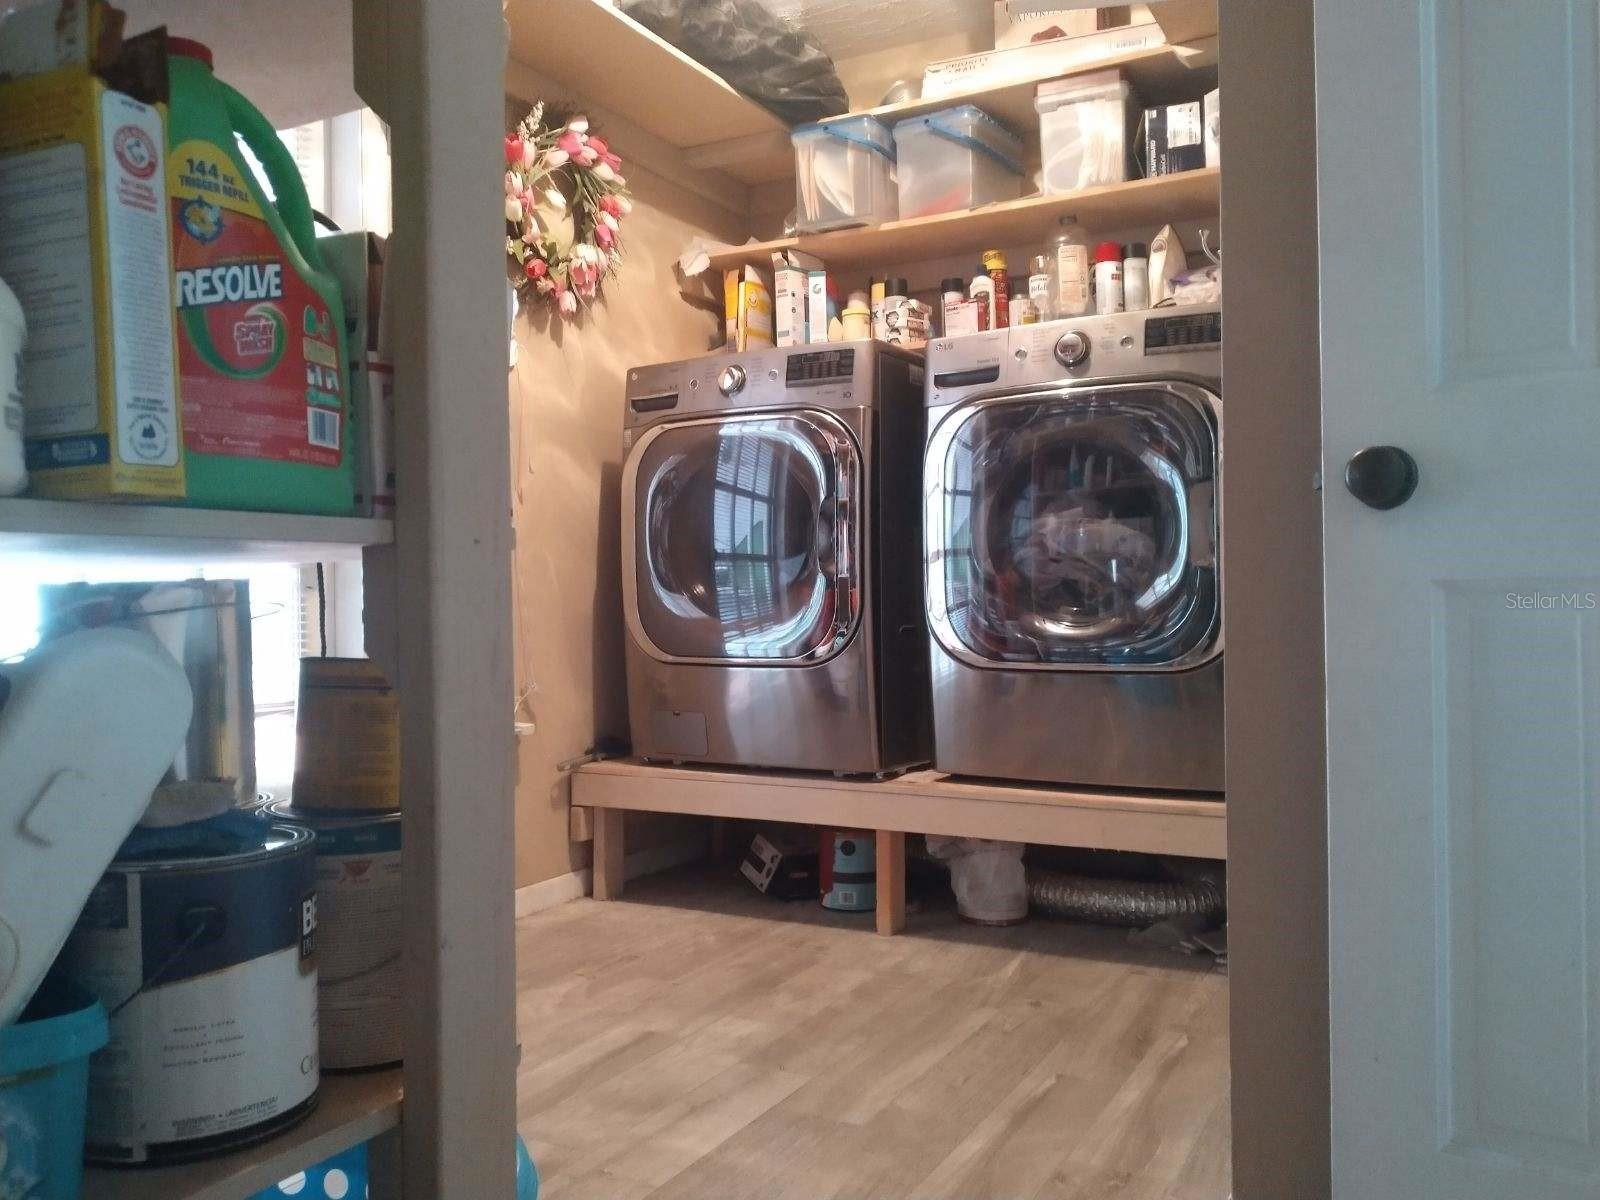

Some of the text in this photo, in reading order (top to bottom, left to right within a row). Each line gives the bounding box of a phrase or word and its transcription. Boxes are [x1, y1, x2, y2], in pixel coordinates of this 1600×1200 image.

[185, 158, 219, 177] 144
[178, 174, 249, 202] TRIGGER REFILL
[175, 263, 283, 308] RESOLVE
